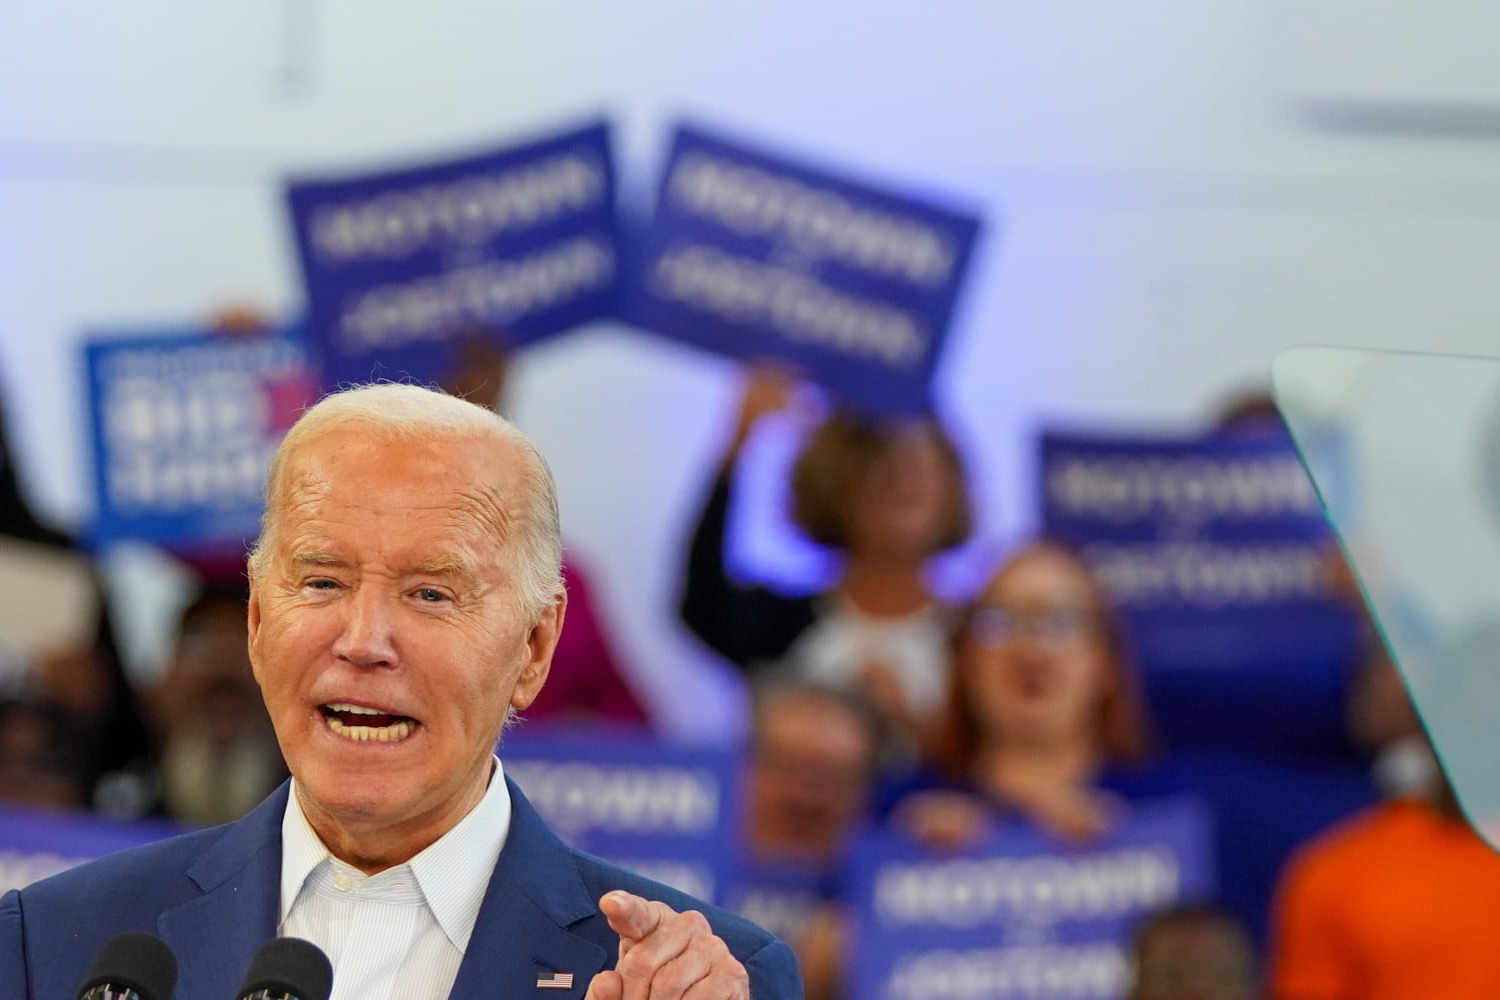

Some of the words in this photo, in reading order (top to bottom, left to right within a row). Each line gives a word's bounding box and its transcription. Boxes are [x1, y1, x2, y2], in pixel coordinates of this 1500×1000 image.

[312, 154, 604, 260] MOTOWN
[670, 155, 956, 288] MOTOWN
[342, 238, 614, 350] JOETOWN
[652, 246, 930, 370] JOETOWN
[1092, 546, 1318, 606] OETOWN
[876, 850, 1180, 926] MOTOWN
